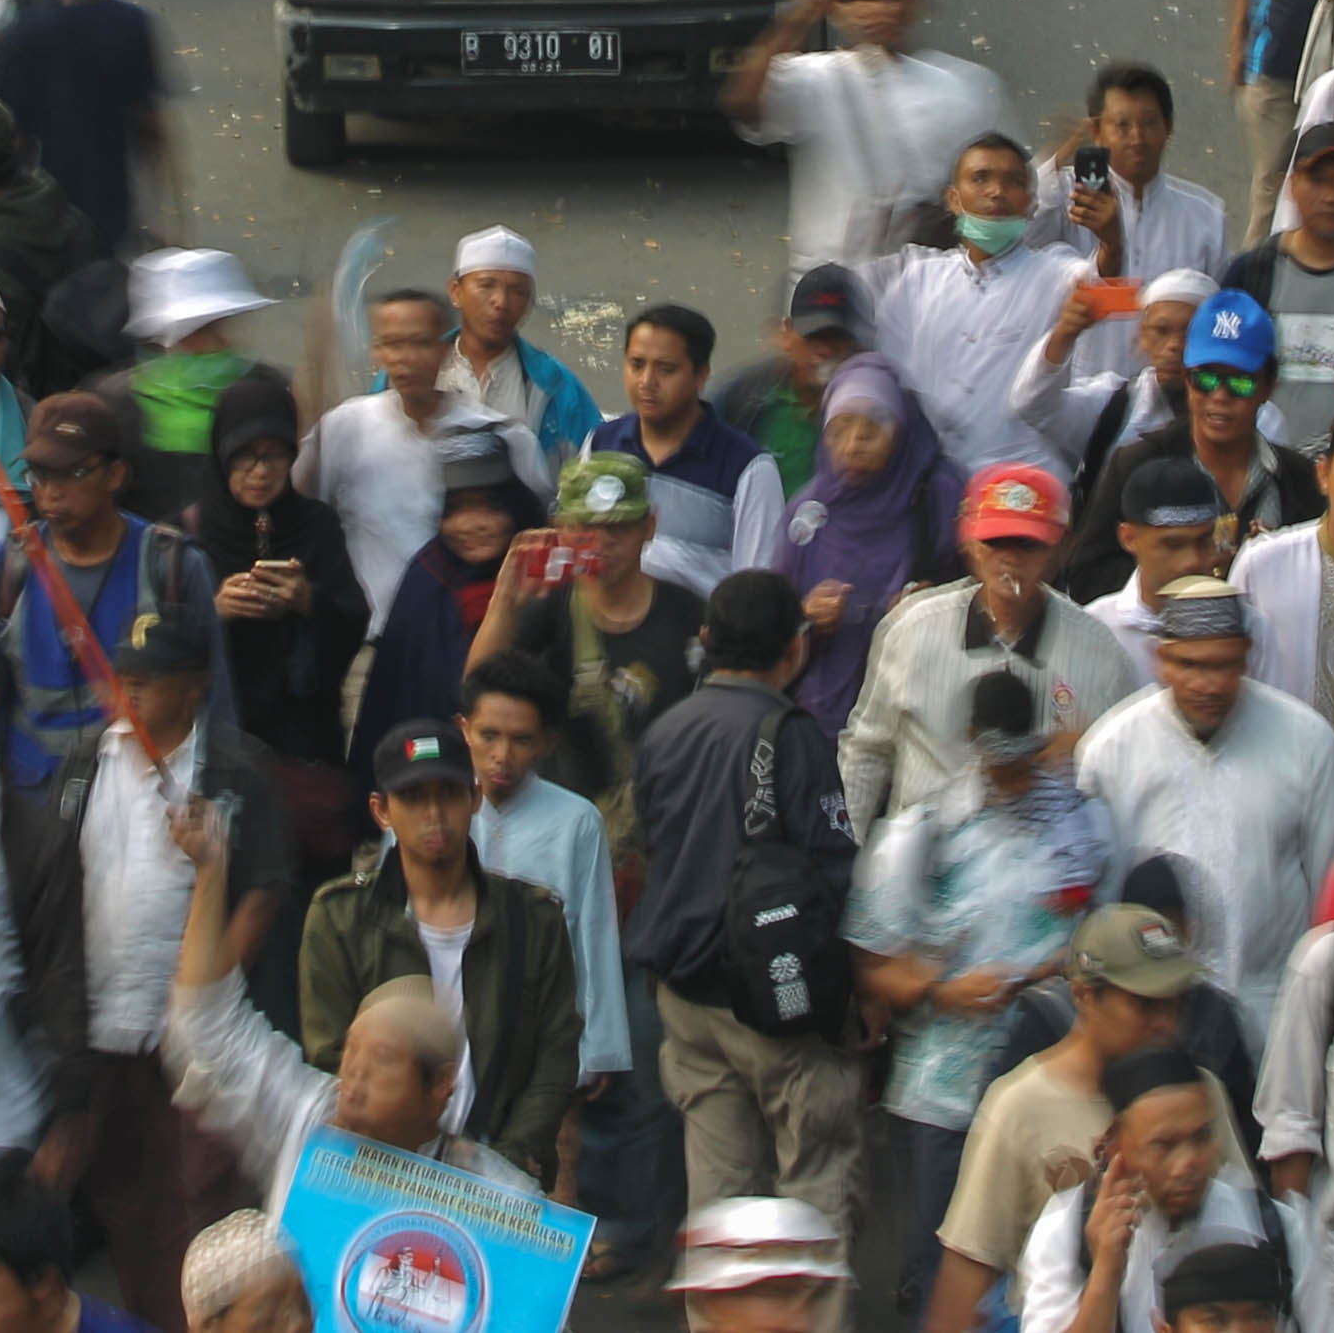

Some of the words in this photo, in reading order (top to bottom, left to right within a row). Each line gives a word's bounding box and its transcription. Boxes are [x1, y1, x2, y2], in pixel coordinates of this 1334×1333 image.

[465, 32, 479, 60] B
[504, 31, 560, 60] 9310
[358, 1145, 400, 1169] IKATAN
[402, 1156, 461, 1191] KELUARGA
[466, 1176, 504, 1205] BESAR
[376, 1167, 454, 1207] MASYARAKAT
[458, 1196, 507, 1225] PECINTA
